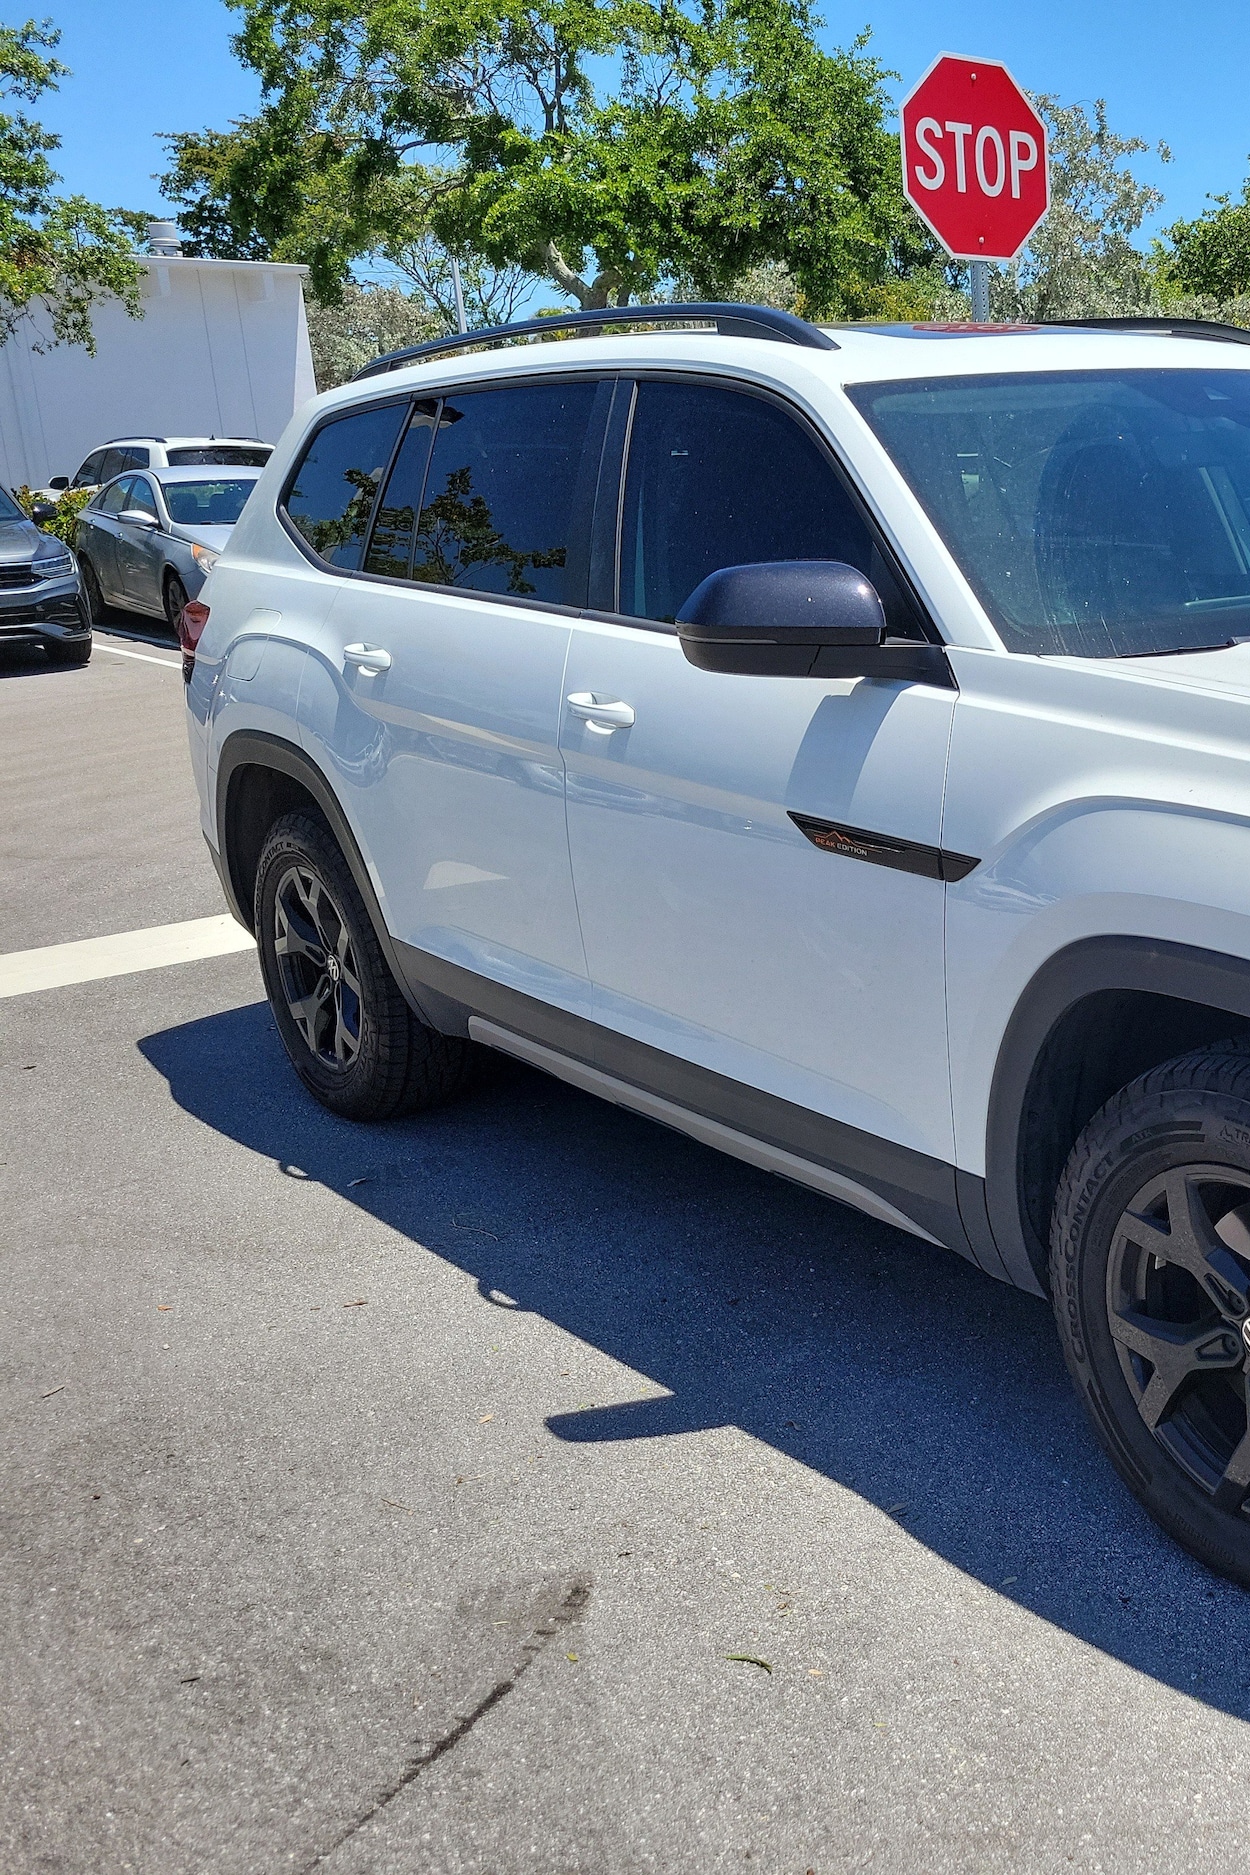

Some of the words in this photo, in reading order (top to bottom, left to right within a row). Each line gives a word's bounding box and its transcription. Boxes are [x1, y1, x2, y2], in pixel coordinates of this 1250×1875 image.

[915, 116, 1038, 199] STOP
[815, 836, 836, 848] PEAK
[836, 842, 868, 856] EDITION
[1064, 1151, 1115, 1364] CROSSCONTACT
